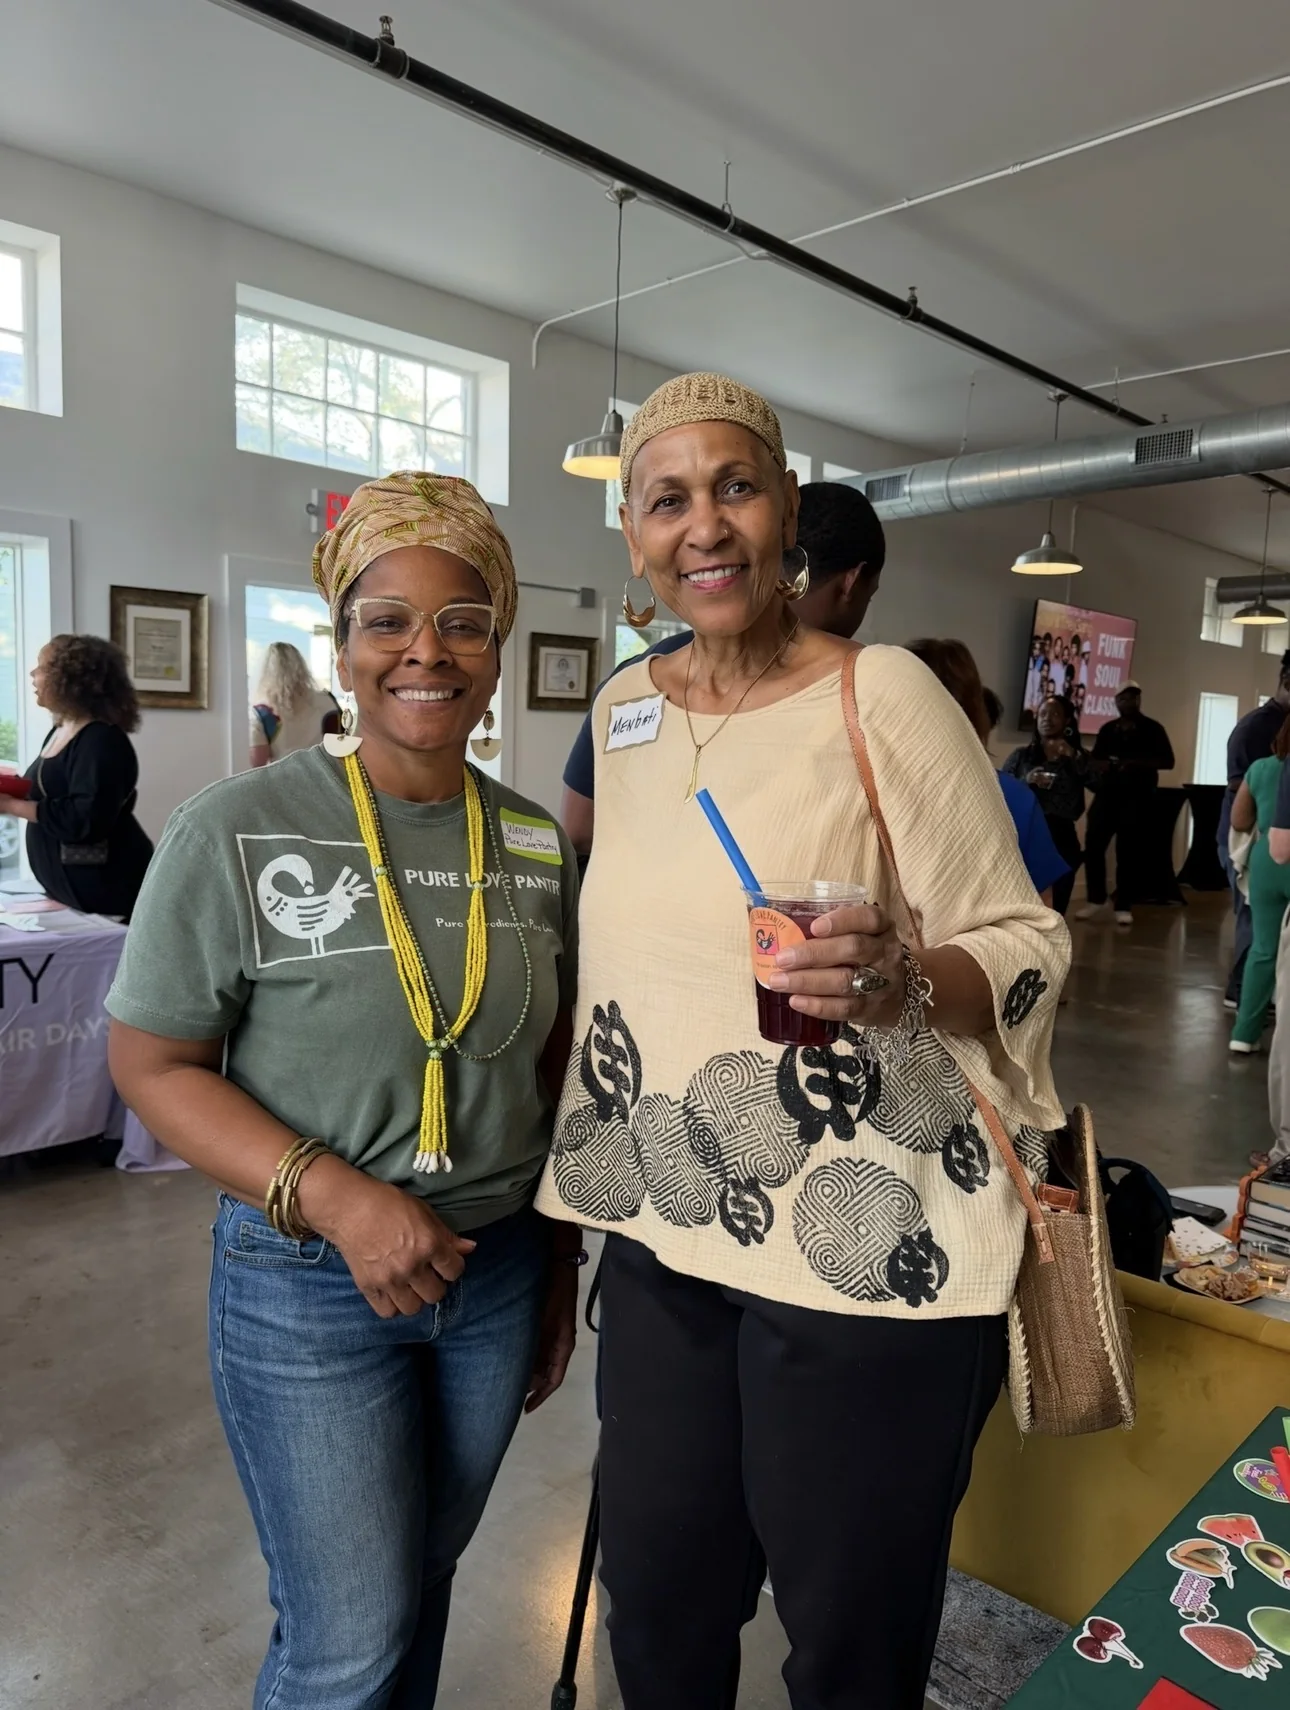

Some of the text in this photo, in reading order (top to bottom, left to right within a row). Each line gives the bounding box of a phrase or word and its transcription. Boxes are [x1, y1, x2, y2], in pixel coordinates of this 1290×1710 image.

[1097, 633, 1127, 660] FUNK
[1094, 664, 1121, 688] SOUL
[404, 869, 460, 888] PURE
[514, 874, 561, 896] PANTR
[435, 917, 464, 928] Pure
